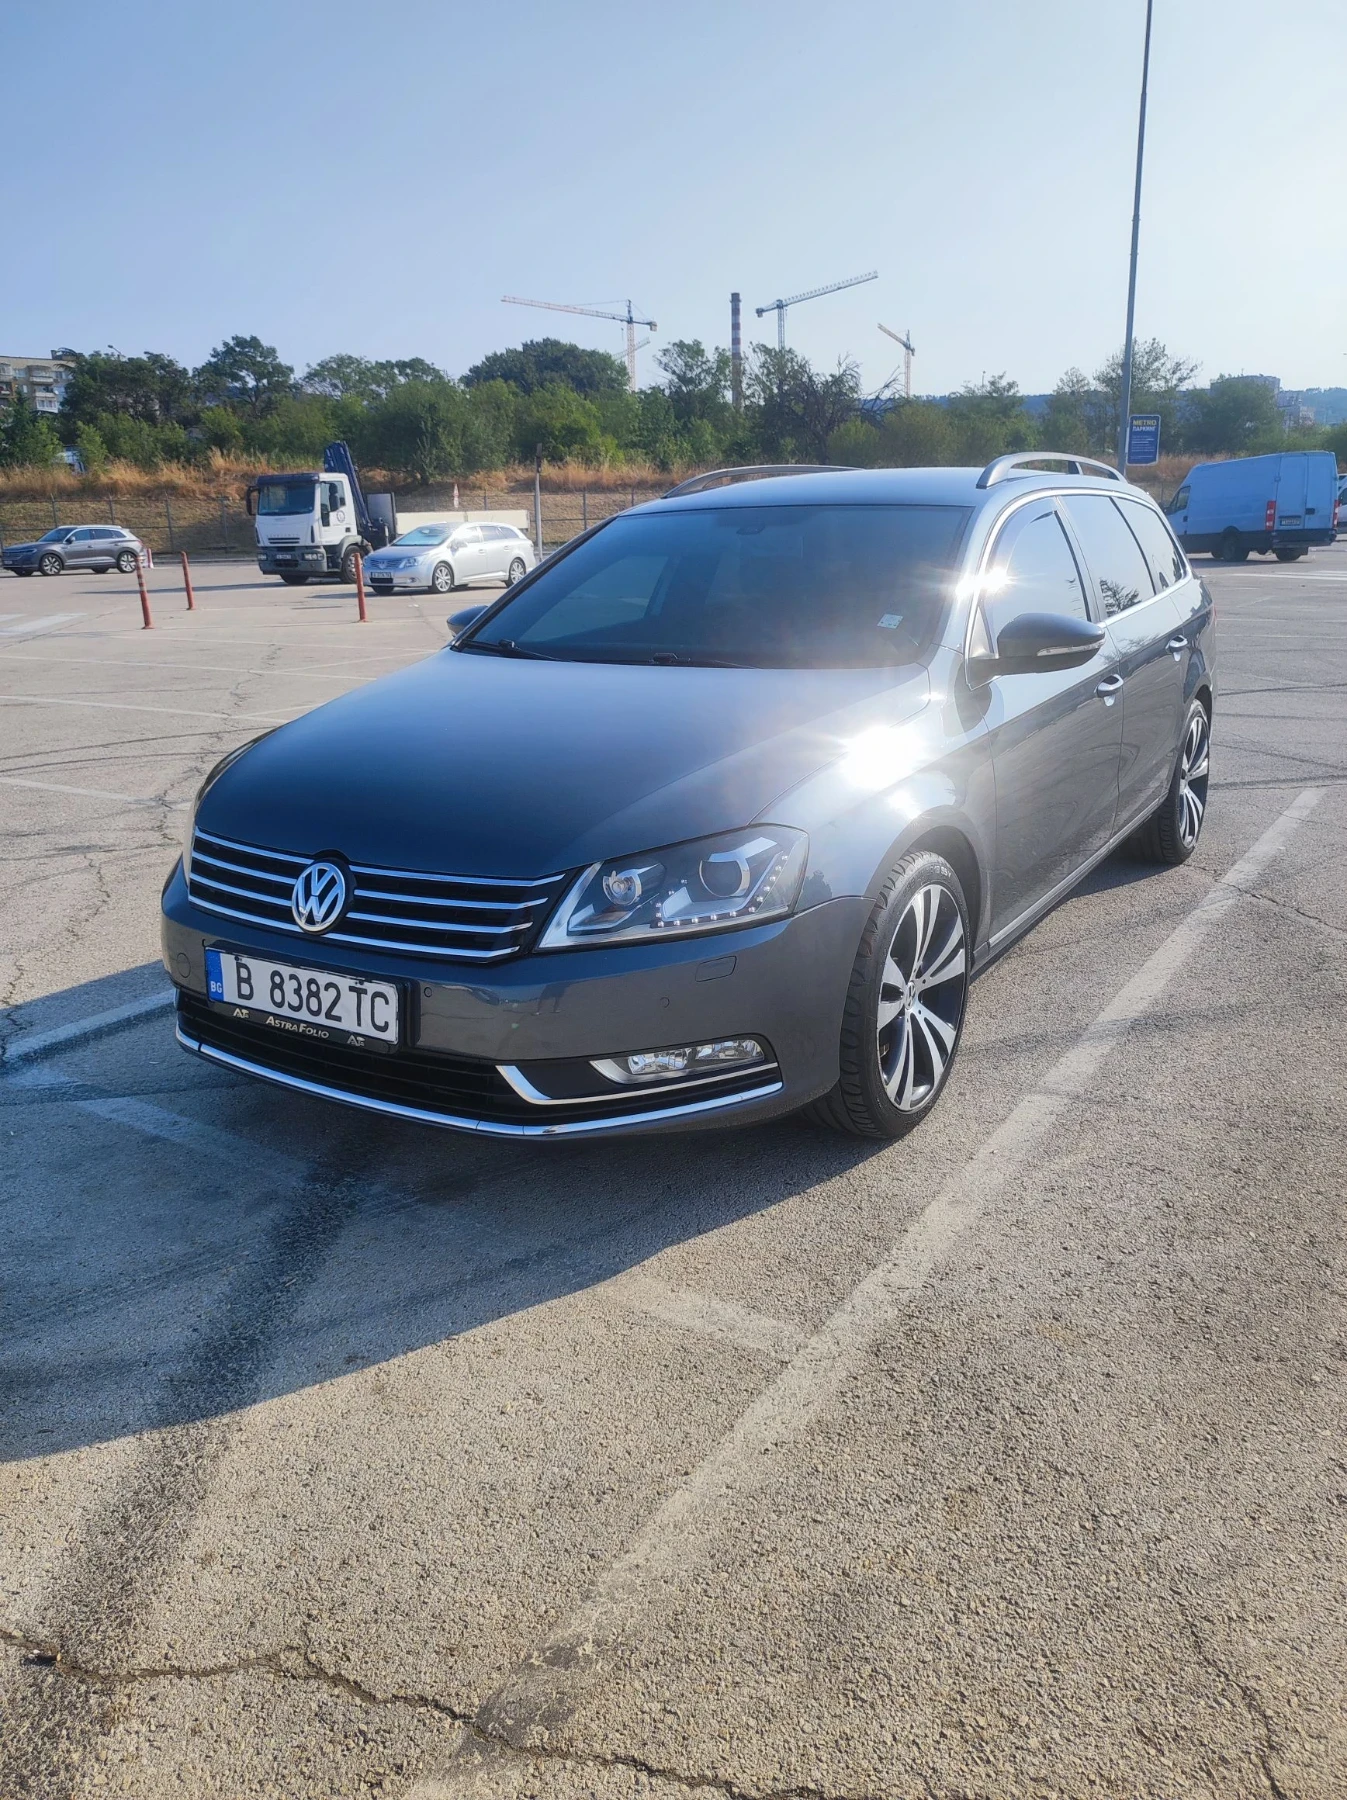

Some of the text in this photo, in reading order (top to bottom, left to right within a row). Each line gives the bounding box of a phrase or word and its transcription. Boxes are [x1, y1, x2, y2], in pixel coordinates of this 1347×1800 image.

[210, 981, 223, 994] BG
[236, 962, 389, 1033] B 8382 TC
